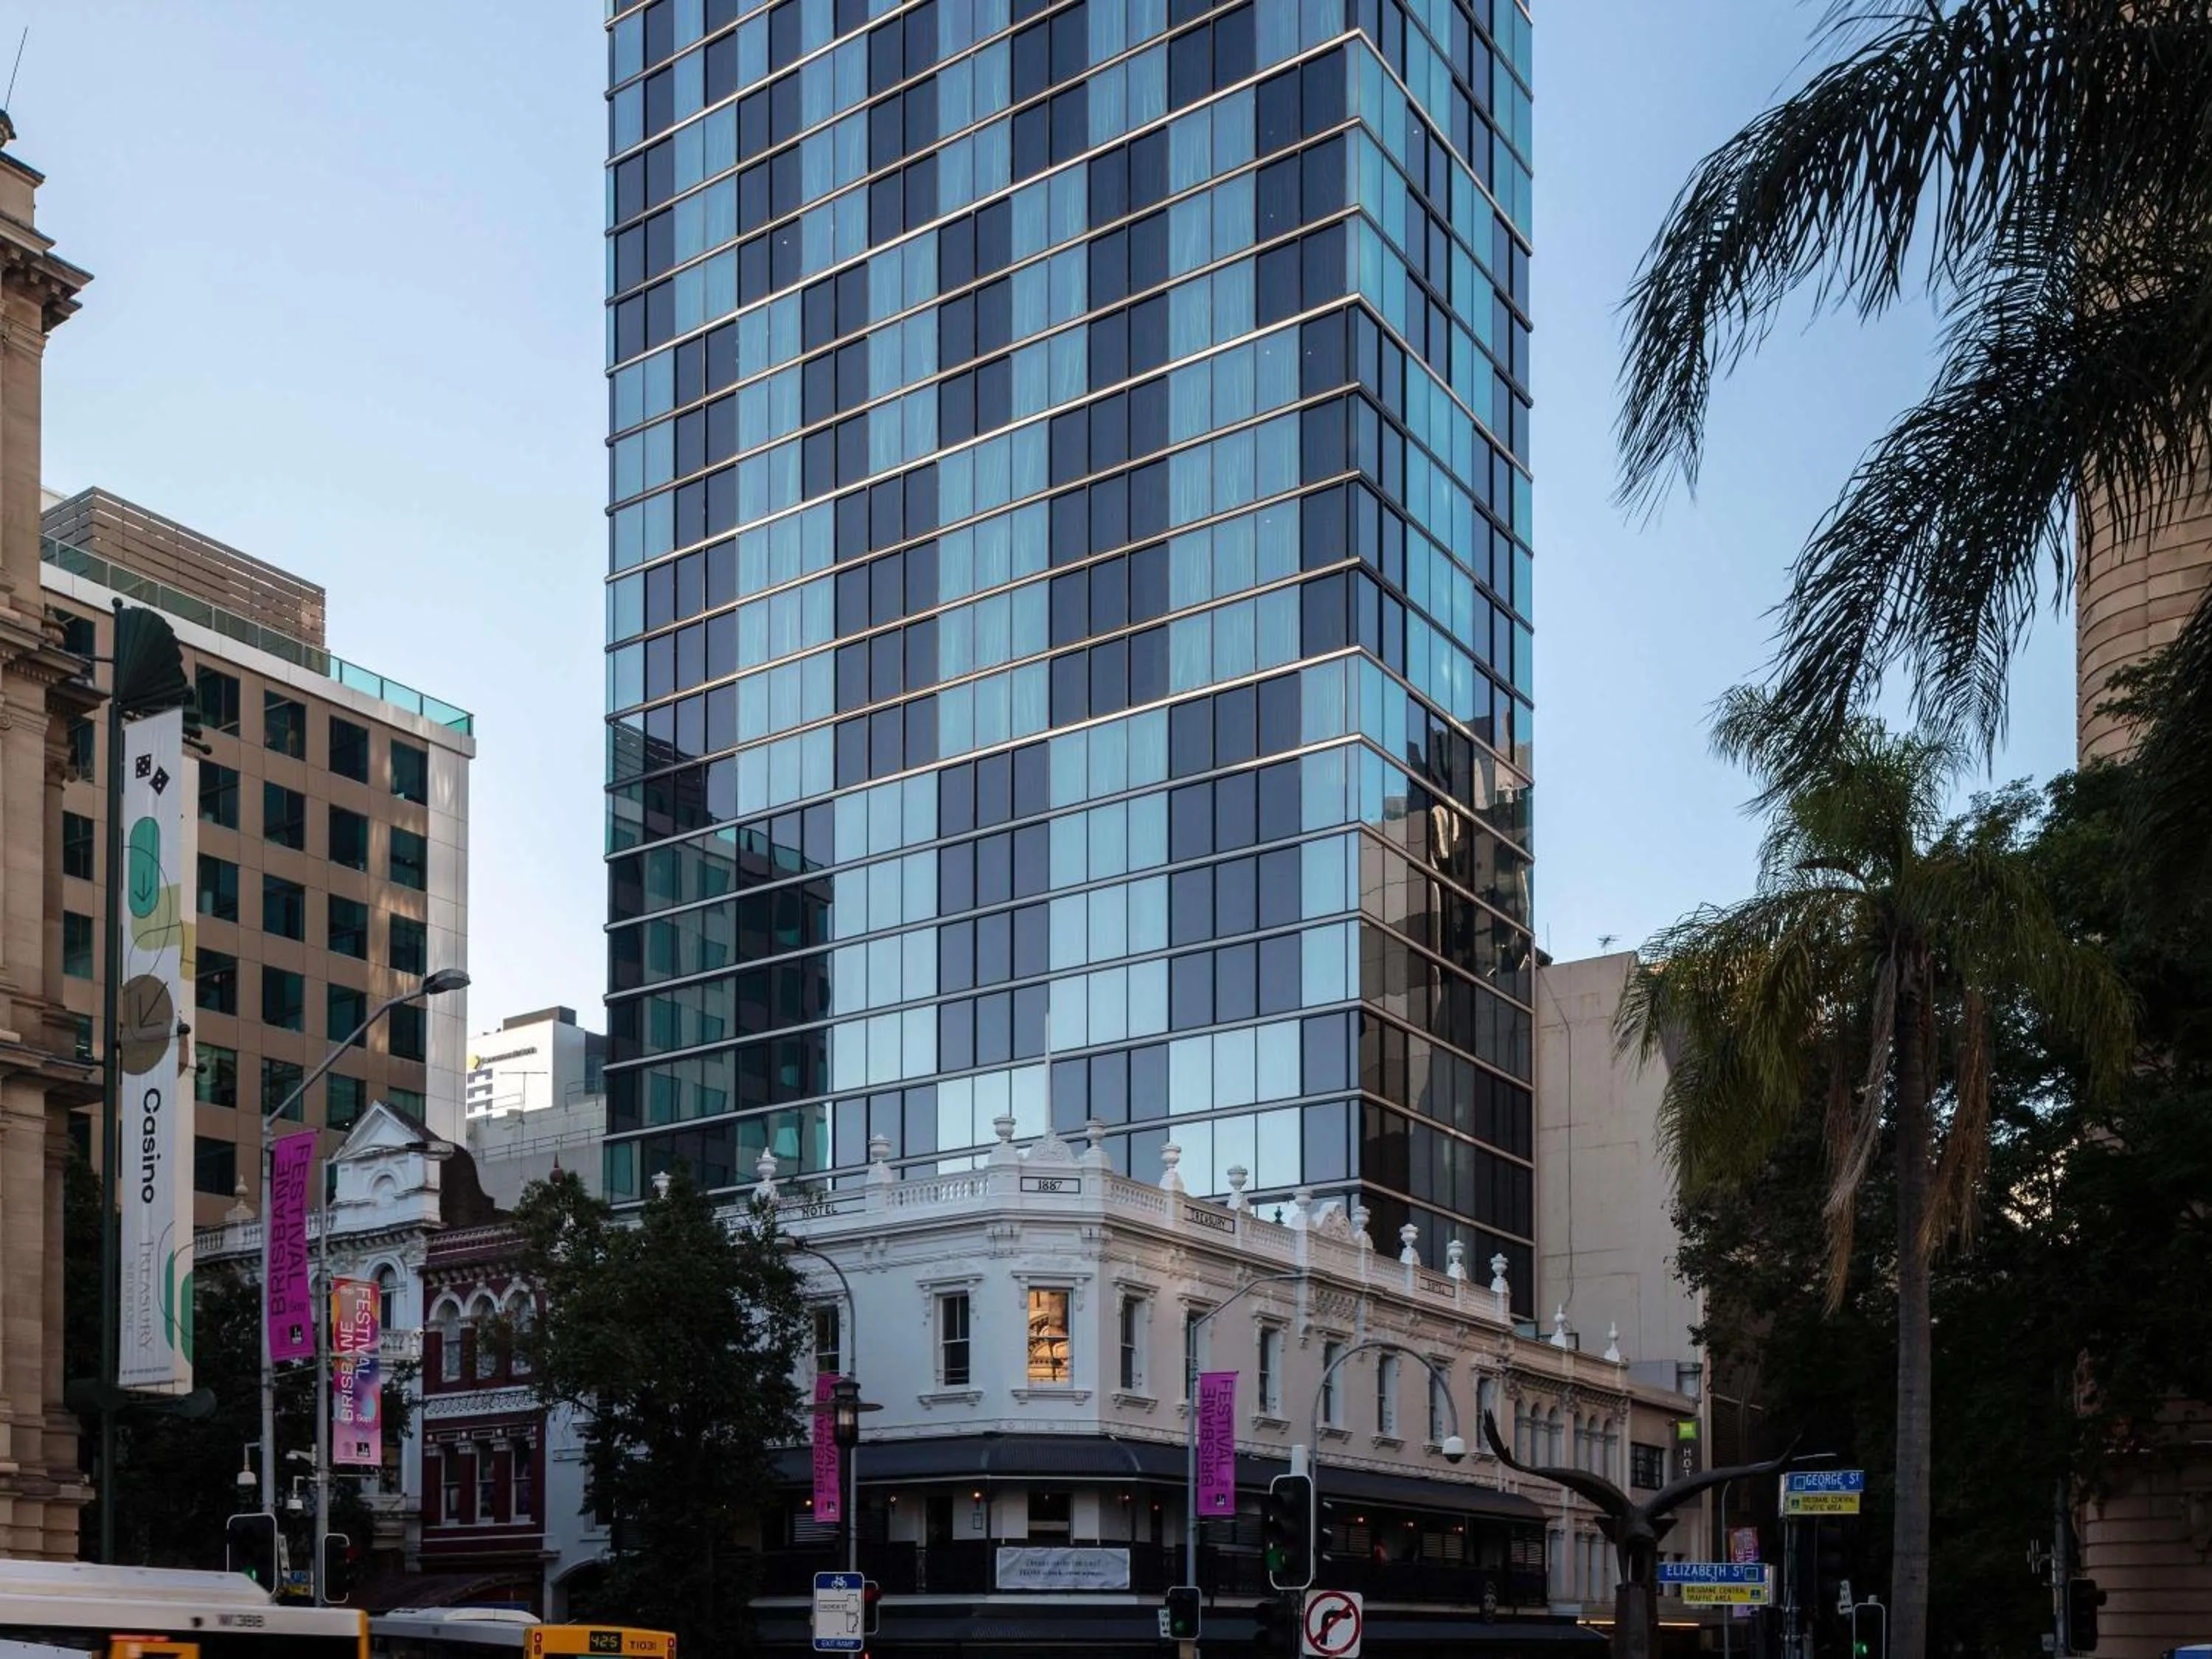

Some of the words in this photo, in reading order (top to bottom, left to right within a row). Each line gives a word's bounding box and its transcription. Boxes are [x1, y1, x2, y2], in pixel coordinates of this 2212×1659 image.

[142, 1088, 161, 1204] Casino
[1038, 1179, 1062, 1191] 1887
[271, 1161, 291, 1316] BRISBANE
[287, 1144, 310, 1290] FESTIVAL
[802, 1203, 838, 1218] HOTEL
[139, 1237, 155, 1352] TREASURY
[355, 1288, 372, 1380] FESTIVAL
[340, 1321, 355, 1422] BRISBANE
[1200, 1387, 1217, 1488] BRISBANE
[1216, 1380, 1234, 1472] FESTIVAL
[1683, 1447, 1692, 1477] HOT
[1806, 1472, 1843, 1486] GEORGE
[1848, 1472, 1860, 1484] ST
[1666, 1564, 1726, 1577] ELIZABETH
[1732, 1565, 1745, 1577] ST
[591, 1635, 618, 1649] 425
[629, 1641, 657, 1651] T1031
